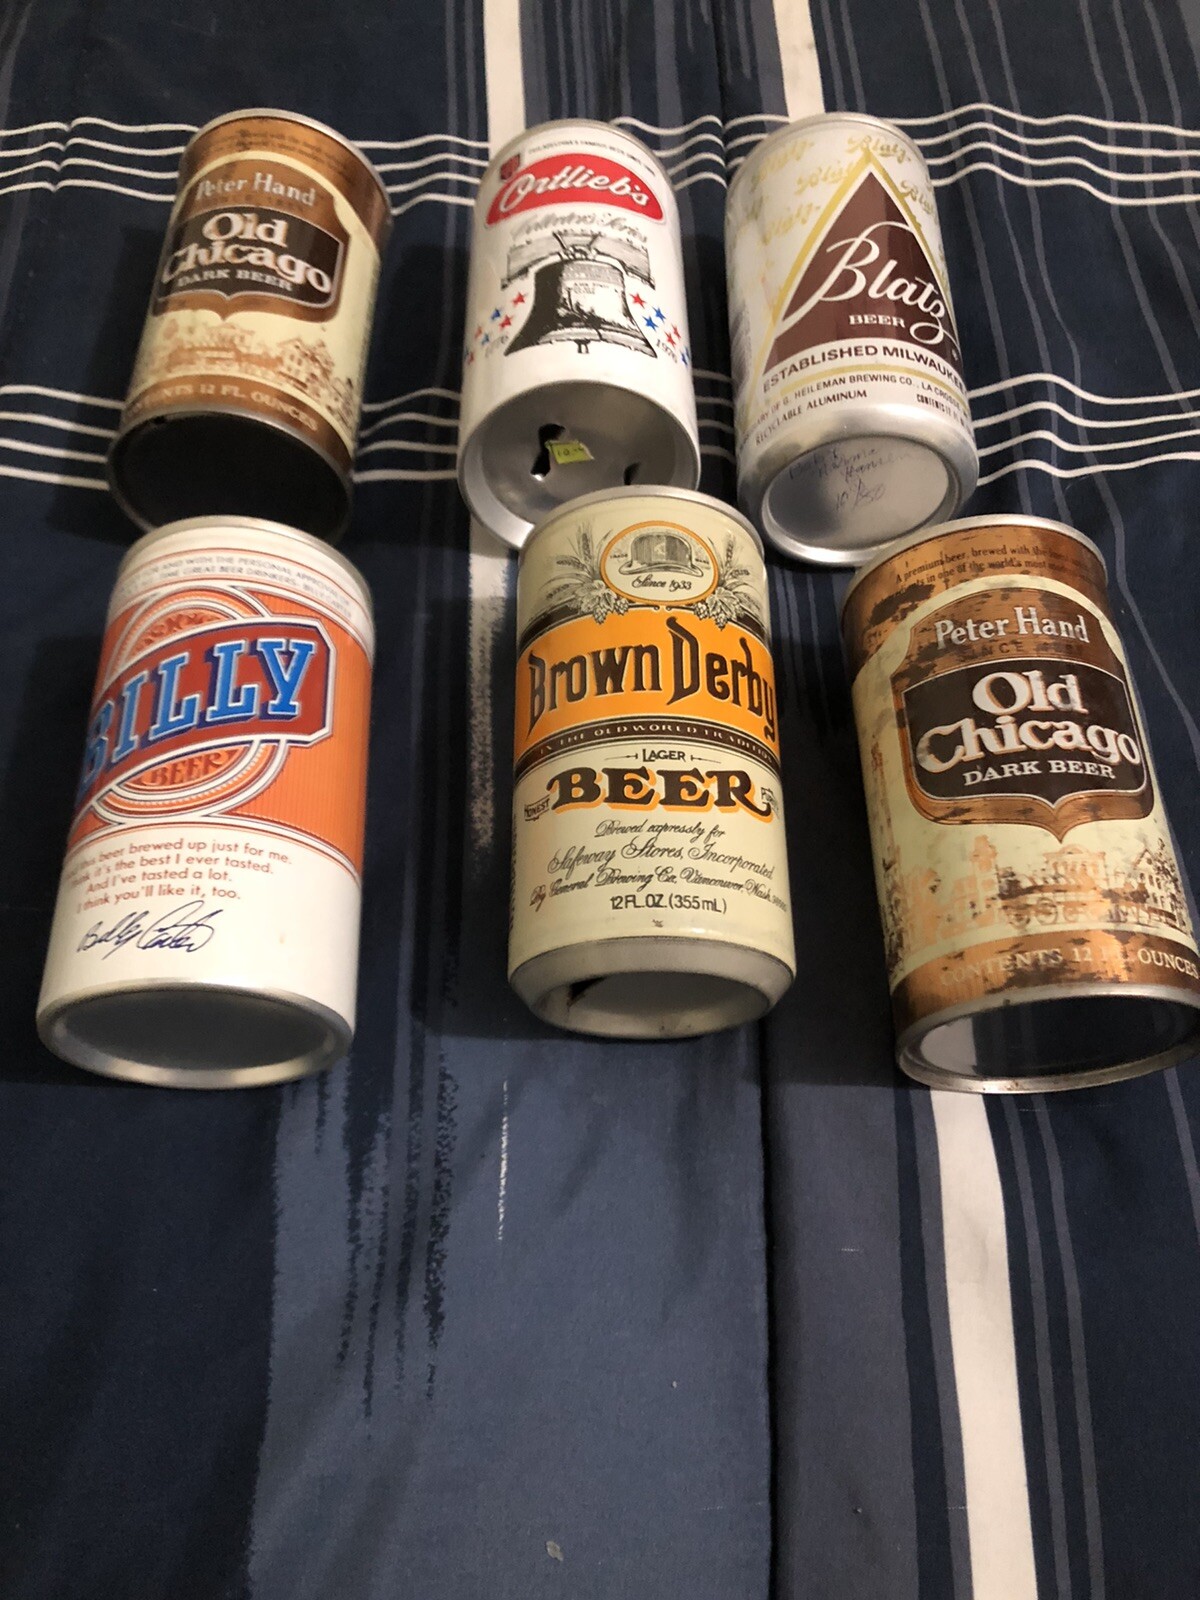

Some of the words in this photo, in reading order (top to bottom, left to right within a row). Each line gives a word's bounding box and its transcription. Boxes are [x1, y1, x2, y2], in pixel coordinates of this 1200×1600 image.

[196, 177, 248, 201] Peter
[254, 171, 317, 207] Hand
[499, 164, 650, 213] Ortlieb's
[202, 212, 288, 248] Old
[161, 241, 331, 293] Chicago
[177, 269, 231, 288] DARK
[235, 269, 293, 292] BEER
[784, 220, 953, 345] Blatz
[849, 314, 906, 329] BEER
[763, 344, 879, 393] ESTABLISHED
[794, 377, 847, 400] HEILEMAN
[849, 373, 898, 384] BREWING
[922, 382, 933, 392] LA
[806, 389, 868, 412] ALUMINUM
[250, 390, 319, 431] OUNCES
[219, 565, 244, 574] BEER
[238, 557, 293, 577] PERSONAL
[895, 573, 903, 585] A
[904, 558, 945, 580] premium
[971, 544, 1008, 558] brewed
[1010, 545, 1030, 555] with
[926, 574, 936, 583] in
[957, 562, 967, 573] of
[988, 557, 1022, 570] world's
[631, 573, 667, 589] Since
[668, 579, 692, 592] 1933
[933, 618, 1009, 650] Peter
[1013, 607, 1090, 644] Hand
[525, 642, 663, 741] Brown
[665, 615, 777, 742] Derby
[972, 669, 1090, 716] Old
[82, 637, 317, 788] BILLY
[594, 725, 628, 737] OLD
[632, 723, 697, 734] WORLD
[915, 714, 1142, 774] Chicago
[148, 750, 227, 787] BEER
[642, 748, 687, 763] LAGER
[963, 760, 1043, 786] DARK
[1048, 760, 1117, 780] BEER
[546, 766, 774, 823] BEER
[594, 819, 647, 838] Brewed
[649, 821, 704, 844] expressly
[705, 824, 726, 844] for
[115, 859, 136, 871] the
[139, 855, 172, 867] best
[175, 853, 181, 865] I
[186, 856, 220, 866] ever
[225, 856, 275, 875] tasted.
[129, 838, 185, 855] brewed
[188, 841, 207, 853] up
[212, 840, 239, 854] just
[243, 842, 264, 857] for
[268, 851, 293, 865] me.
[547, 846, 618, 880] Safeway
[620, 836, 684, 862] Stores,
[687, 842, 775, 879] Incorporated
[86, 876, 111, 895] And
[112, 874, 137, 887] I've
[141, 869, 189, 881] tasted
[192, 870, 203, 880] a
[208, 867, 232, 882] lot.
[114, 884, 154, 906] you'll
[158, 883, 186, 896] like
[190, 884, 206, 898] it,
[212, 886, 241, 900] too.
[549, 872, 595, 897] General
[594, 866, 655, 893] Brewing
[1072, 946, 1093, 962] 12
[1136, 947, 1200, 980] OUNCES
